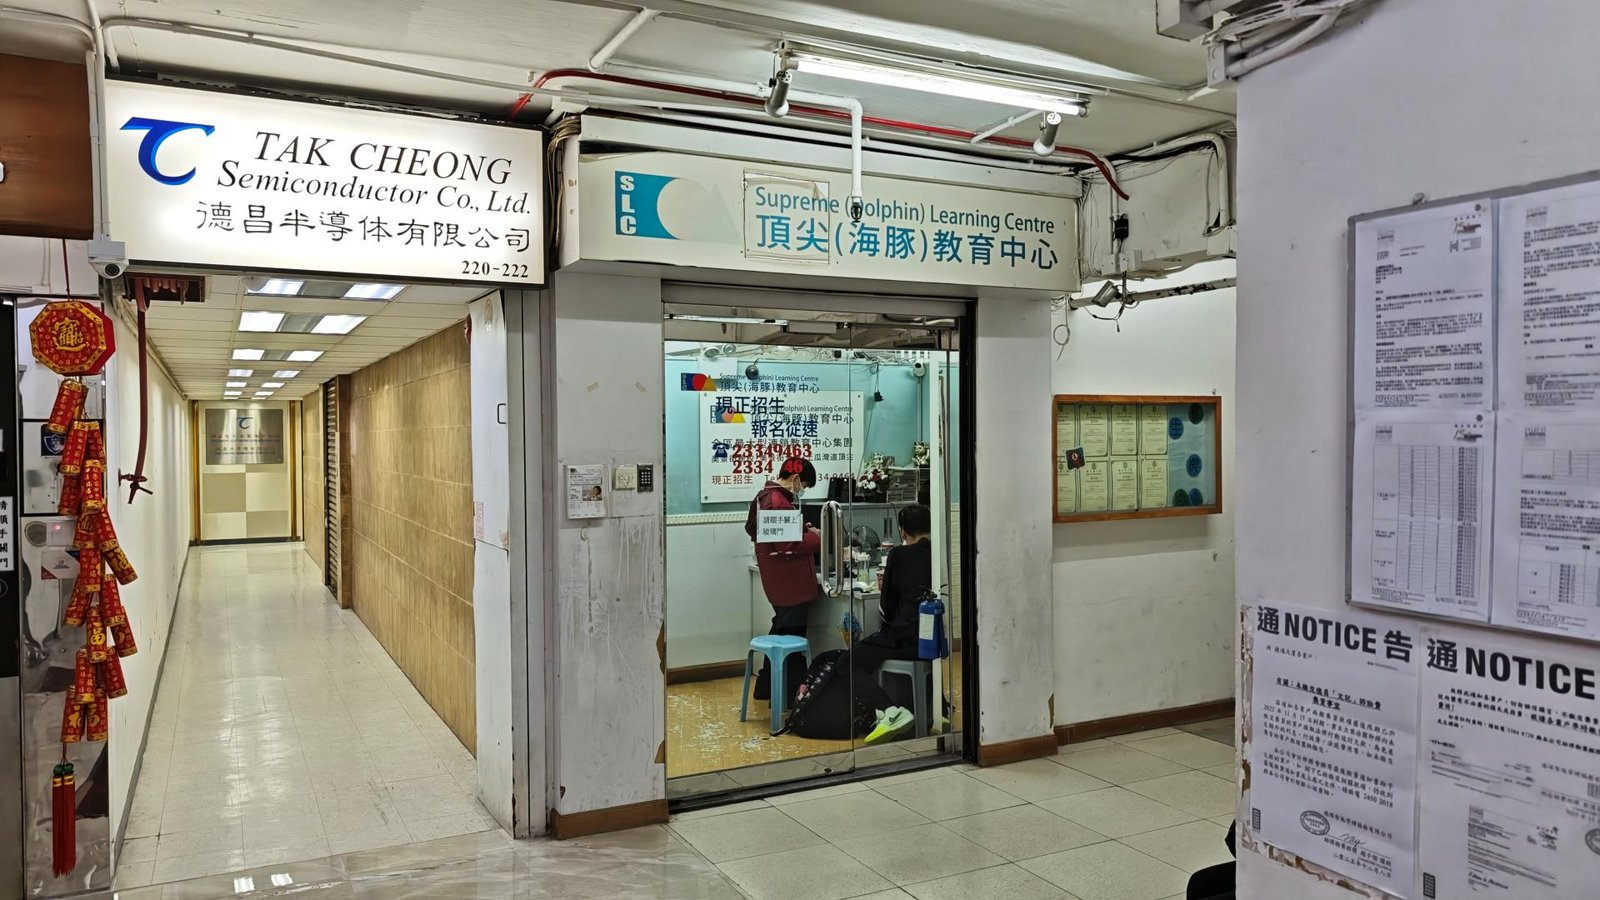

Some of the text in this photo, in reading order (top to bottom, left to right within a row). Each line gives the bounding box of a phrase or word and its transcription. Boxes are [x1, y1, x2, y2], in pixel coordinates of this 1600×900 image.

[254, 131, 512, 184] TAK CHEONG
[217, 160, 531, 214] Semiconductor Co., Ltd.
[619, 174, 637, 236] SLC
[755, 187, 840, 217] Supreme
[929, 209, 1000, 233] Learning
[1004, 212, 1055, 235] Centre
[197, 201, 530, 252] 德昌半導体有限公司
[757, 215, 1059, 270] 頂尖(海豚)教育中心
[462, 260, 528, 279] 220-222
[720, 381, 820, 394] 頂尖(海豚)教育中心
[775, 375, 800, 383] Learning
[716, 396, 785, 416] 現正招生
[807, 405, 833, 414] Learning
[751, 419, 818, 438] 報名從速
[733, 443, 812, 458] 23349463
[733, 460, 773, 474] 2334
[712, 475, 753, 485] 現正招生
[1257, 605, 1280, 635] 通
[1284, 612, 1377, 654] NOTICE
[1384, 630, 1413, 663] 告
[1427, 638, 1595, 700] 通 NOTICE
